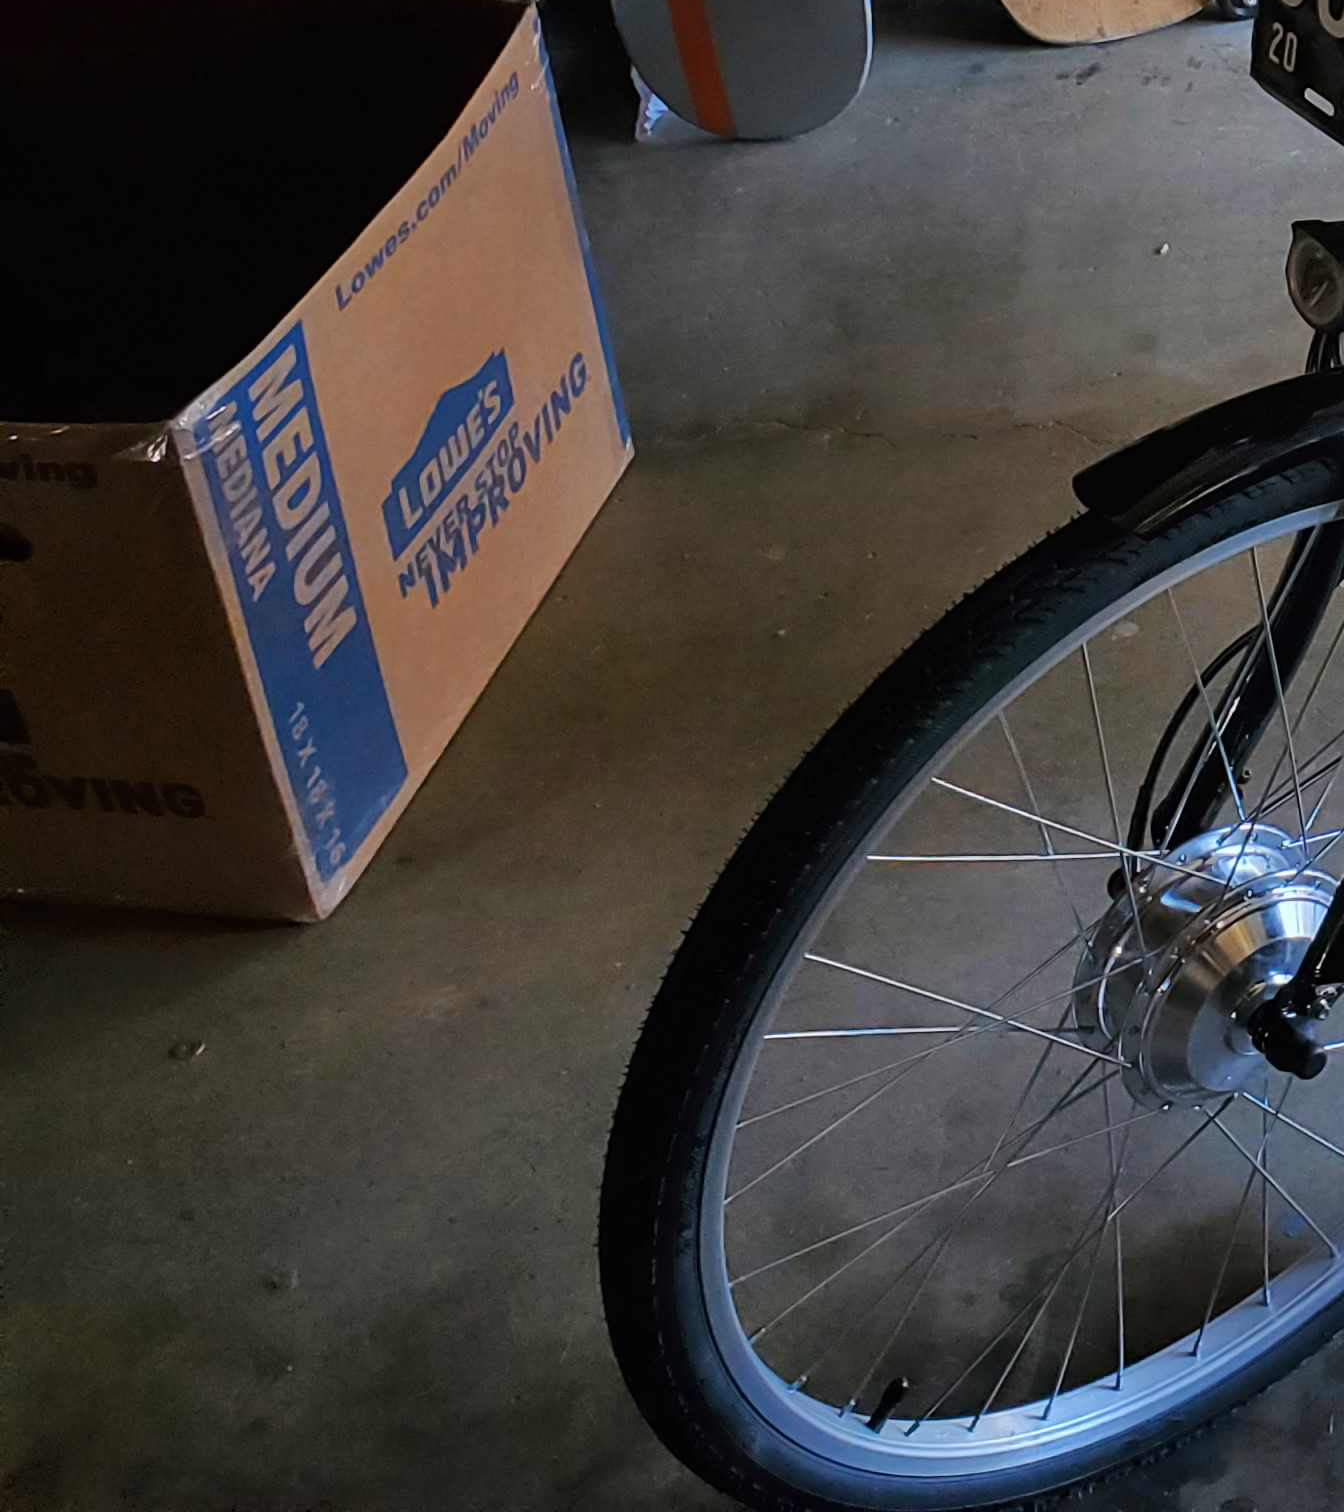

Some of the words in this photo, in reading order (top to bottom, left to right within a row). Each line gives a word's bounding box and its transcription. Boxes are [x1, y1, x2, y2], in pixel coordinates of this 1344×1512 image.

[1268, 21, 1297, 73] 20
[335, 71, 519, 311] Lowes.com/Moving
[207, 401, 276, 602] MEDIANA
[249, 344, 357, 669] MEDIUM
[398, 493, 469, 598] NEVER
[474, 421, 519, 493] STOP
[399, 380, 500, 529] LOWE'S
[424, 352, 586, 609] IMPROVING
[289, 702, 309, 740] 18
